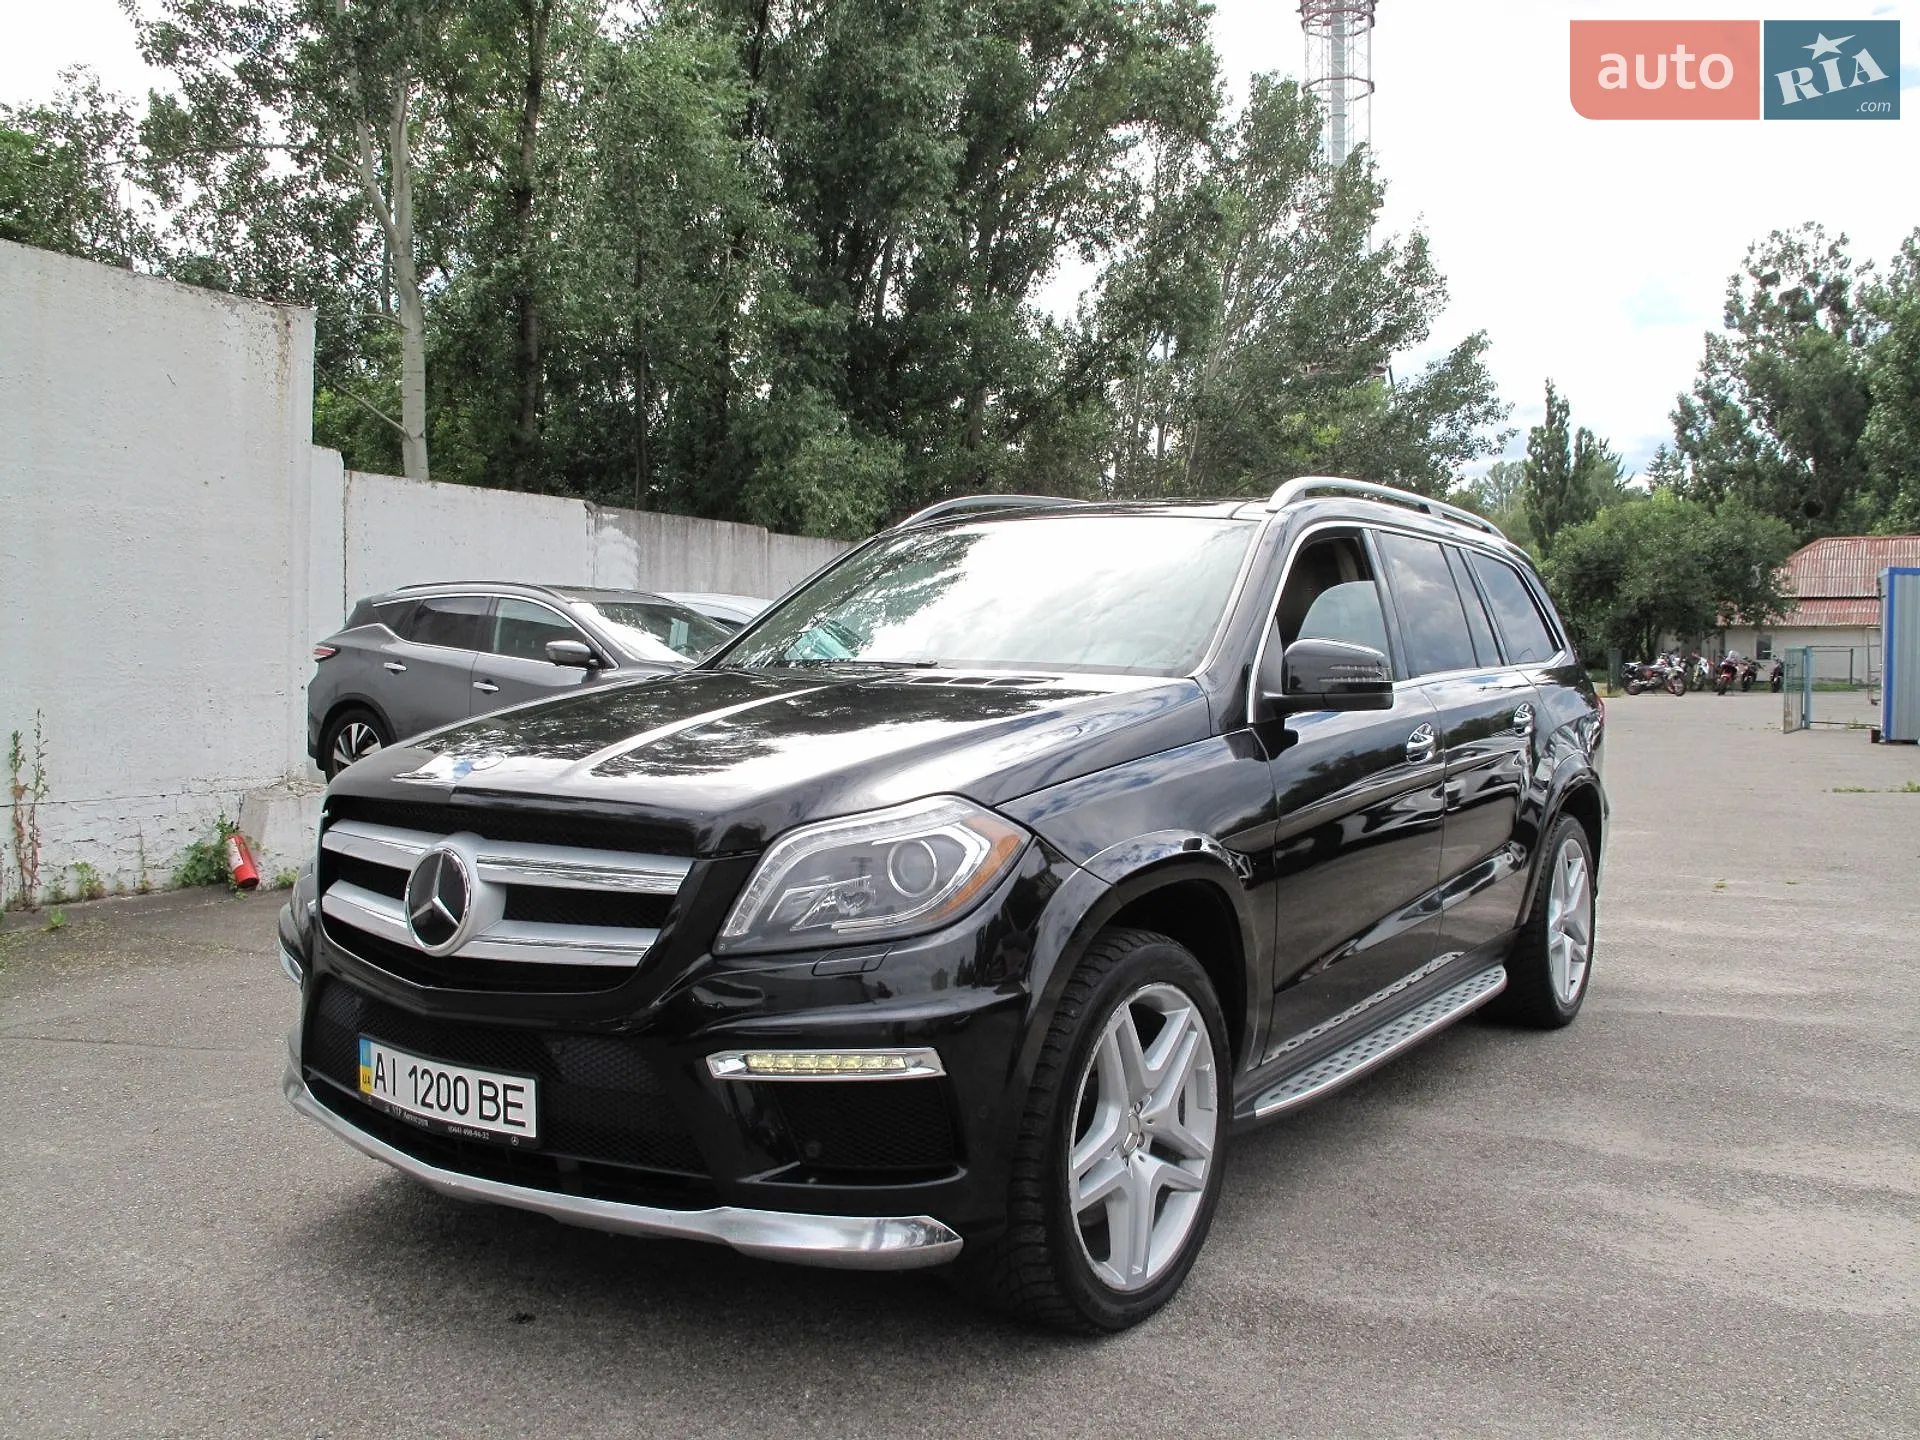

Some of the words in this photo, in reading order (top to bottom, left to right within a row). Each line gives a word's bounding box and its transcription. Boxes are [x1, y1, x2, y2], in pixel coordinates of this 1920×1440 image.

[362, 1075, 371, 1085] UA
[374, 1052, 396, 1097] AI
[408, 1064, 470, 1116] 1200
[478, 1079, 526, 1128] BE
